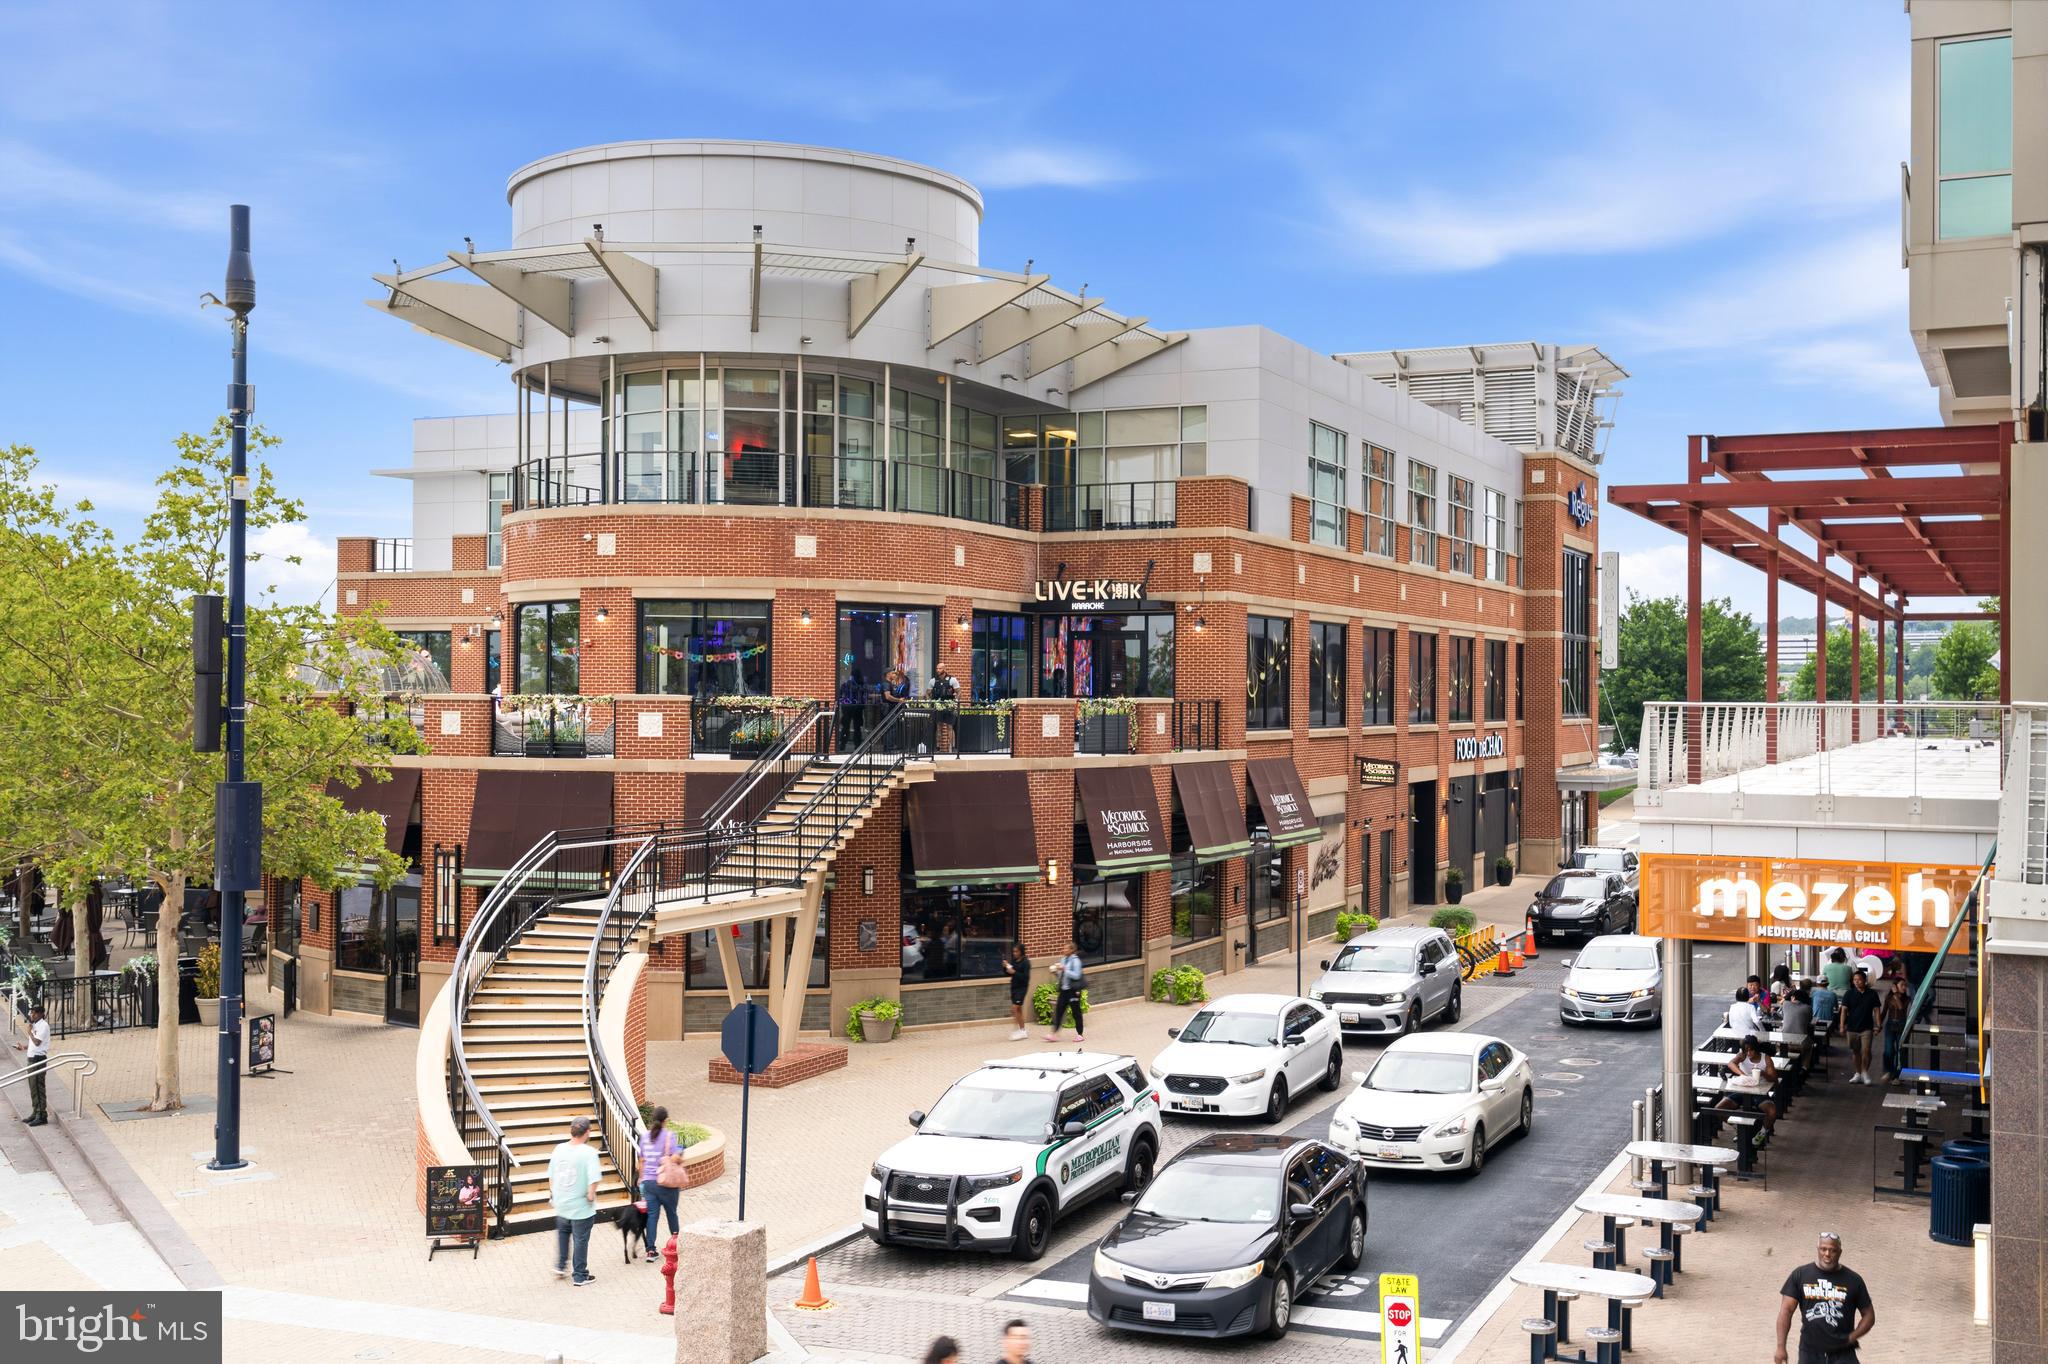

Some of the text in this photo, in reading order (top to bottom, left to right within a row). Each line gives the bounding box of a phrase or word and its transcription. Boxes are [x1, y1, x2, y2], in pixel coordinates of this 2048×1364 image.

[1572, 491, 1593, 527] Regus
[1035, 580, 1109, 600] LIVE-K
[1071, 602, 1105, 610] KARAOKE
[1456, 736, 1477, 760] FOGO
[1106, 839, 1153, 849] HARBORSIDE
[1700, 871, 1950, 928] mezeh
[1757, 925, 1887, 943] MEDITERRANEAN GRILL
[1070, 1134, 1121, 1170] METROPOLITAN
[1386, 1277, 1411, 1286] STATE
[1391, 1285, 1407, 1294] LAW
[1388, 1309, 1411, 1320] STOP
